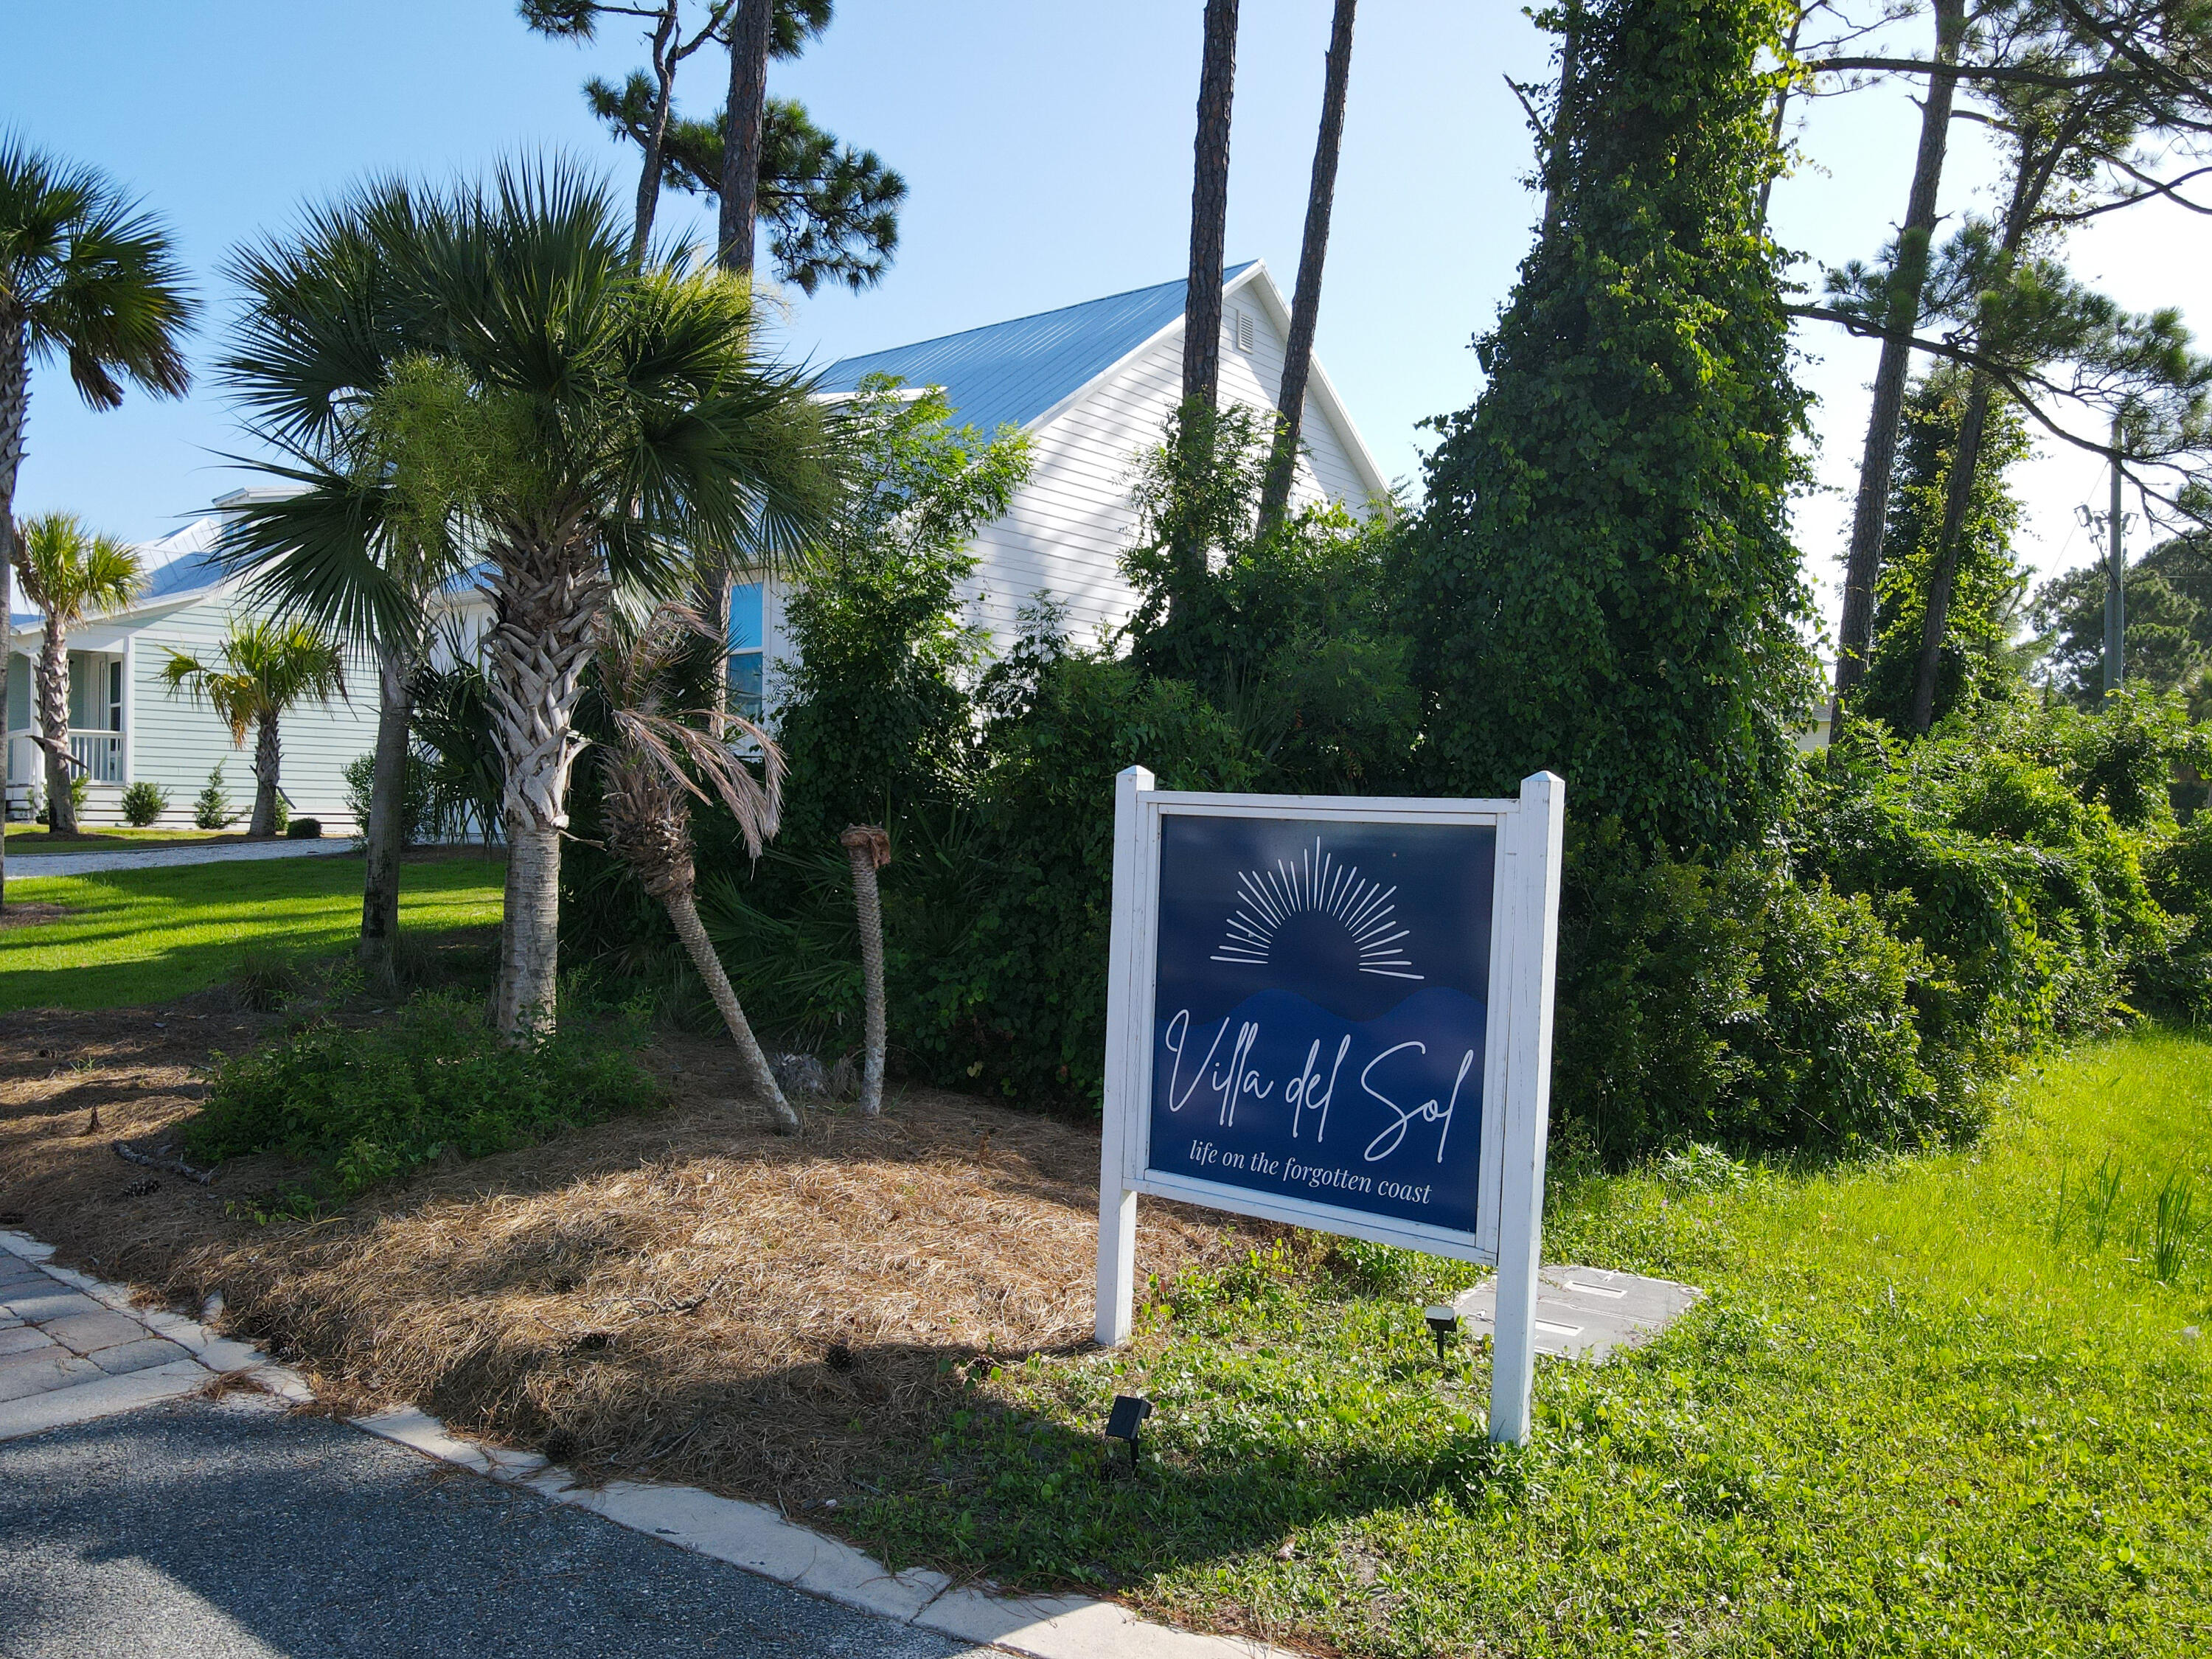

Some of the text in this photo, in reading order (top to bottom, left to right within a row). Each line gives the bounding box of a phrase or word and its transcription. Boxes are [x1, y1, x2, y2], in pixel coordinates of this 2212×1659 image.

[1165, 1009, 1474, 1164] Villa del Sol
[1189, 1139, 1433, 1204] life on the forgotten coast
